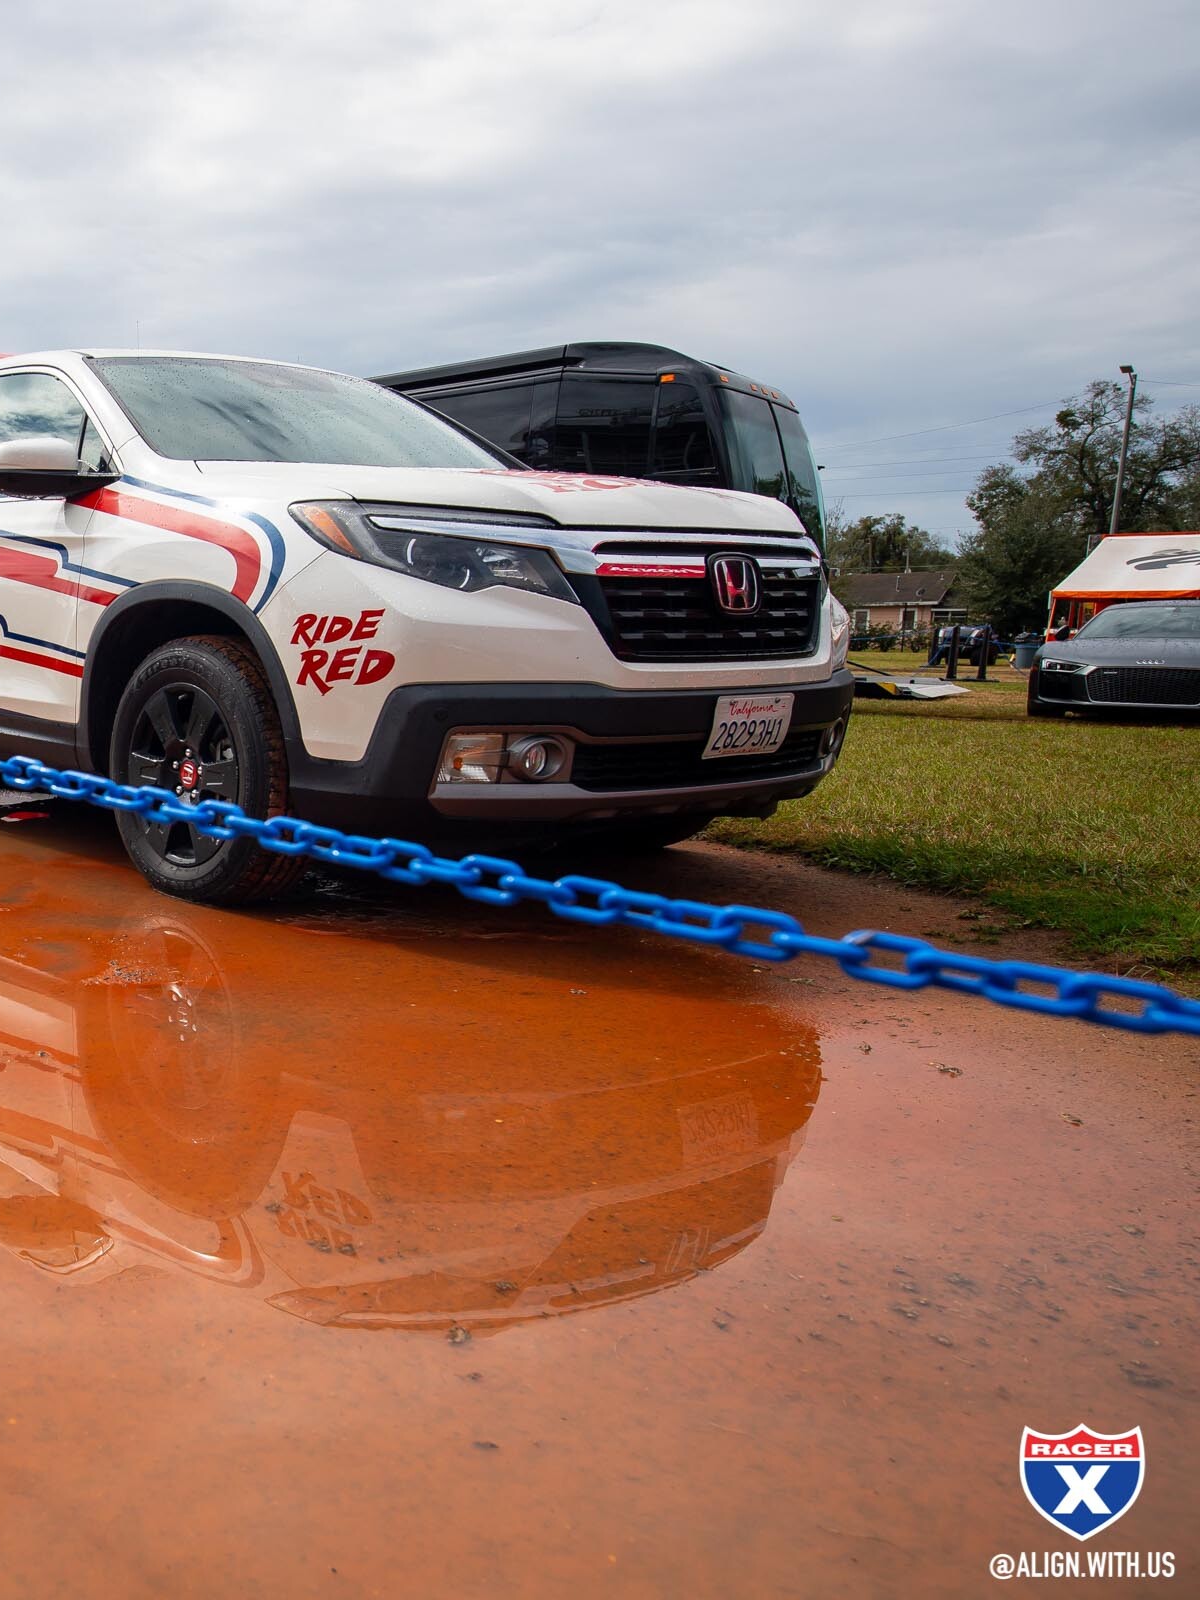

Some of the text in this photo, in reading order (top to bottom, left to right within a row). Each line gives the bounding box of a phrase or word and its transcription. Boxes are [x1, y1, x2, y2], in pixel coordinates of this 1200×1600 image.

[290, 608, 385, 649] RIDE
[296, 645, 395, 696] RED
[729, 700, 778, 719] California
[711, 719, 783, 751] 28293H1
